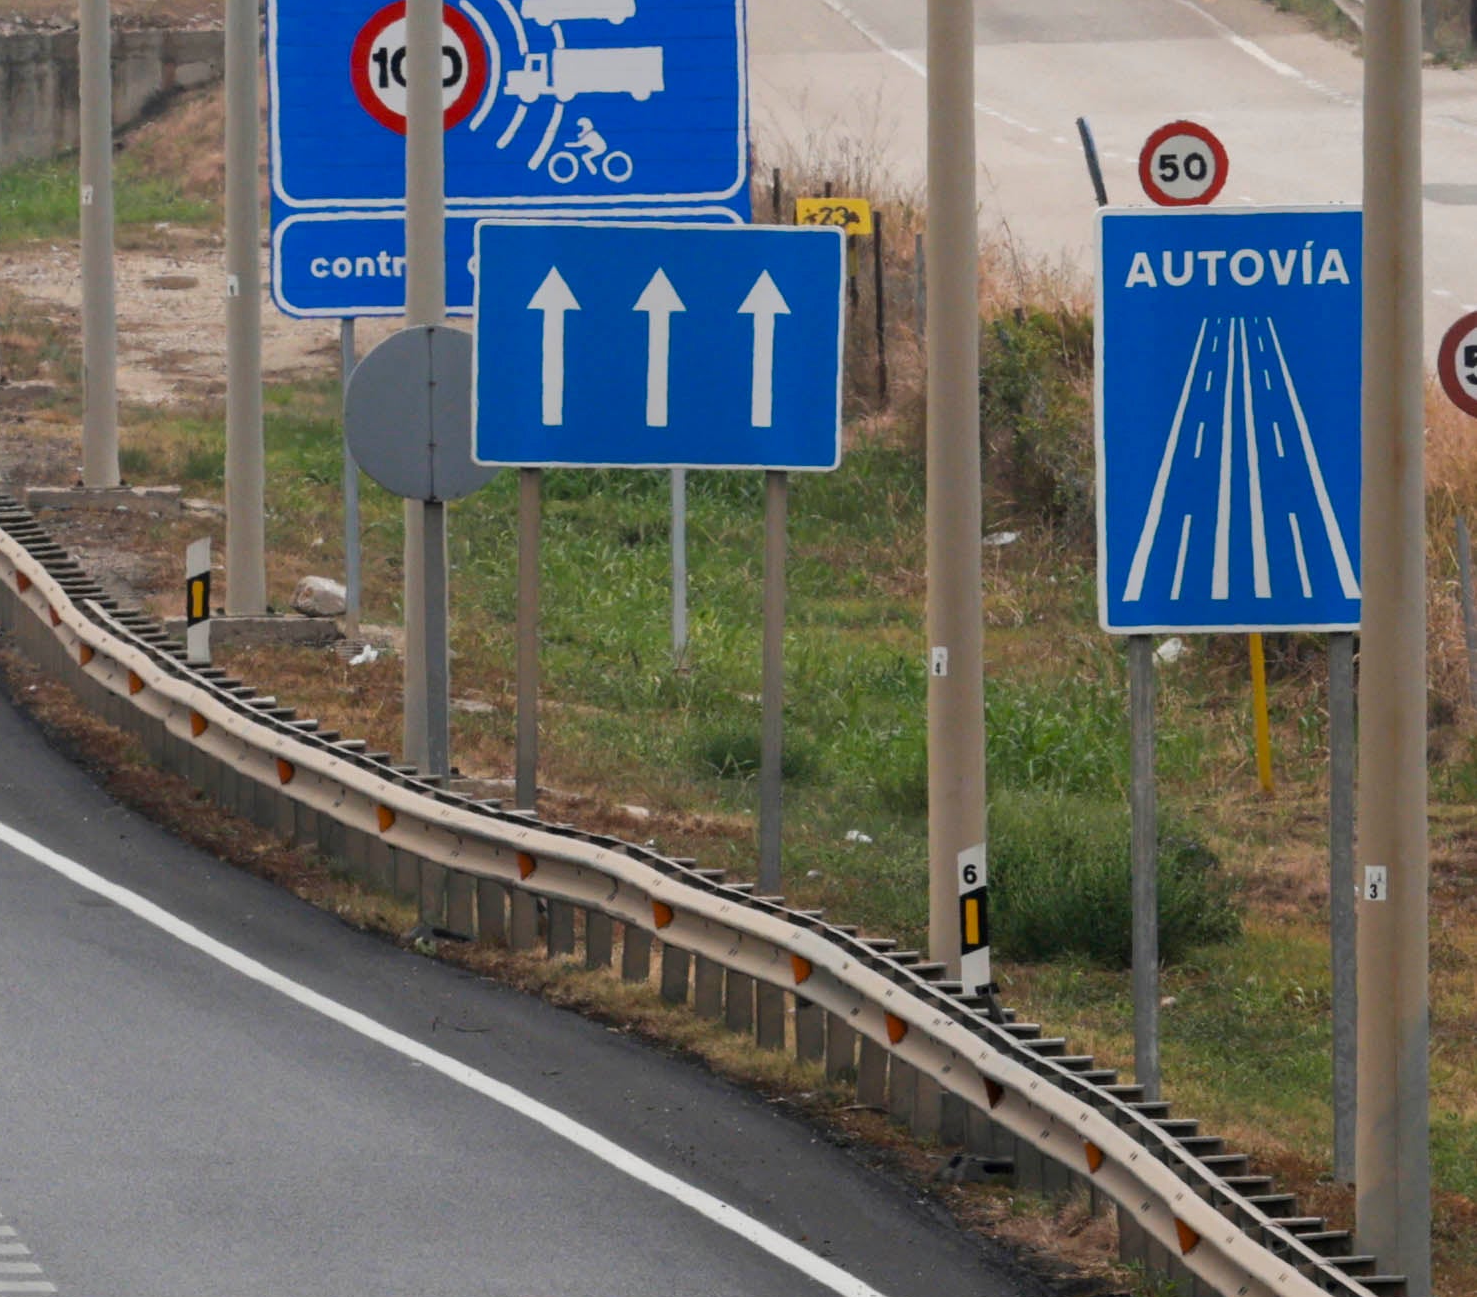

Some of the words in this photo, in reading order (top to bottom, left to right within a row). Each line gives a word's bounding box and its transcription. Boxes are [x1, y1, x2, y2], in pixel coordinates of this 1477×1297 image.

[1158, 151, 1208, 183] 50
[309, 251, 407, 279] contr
[1124, 240, 1351, 288] AUTOVÍA
[1463, 344, 1477, 386] 5
[962, 864, 977, 885] 6
[1368, 883, 1377, 899] 3
